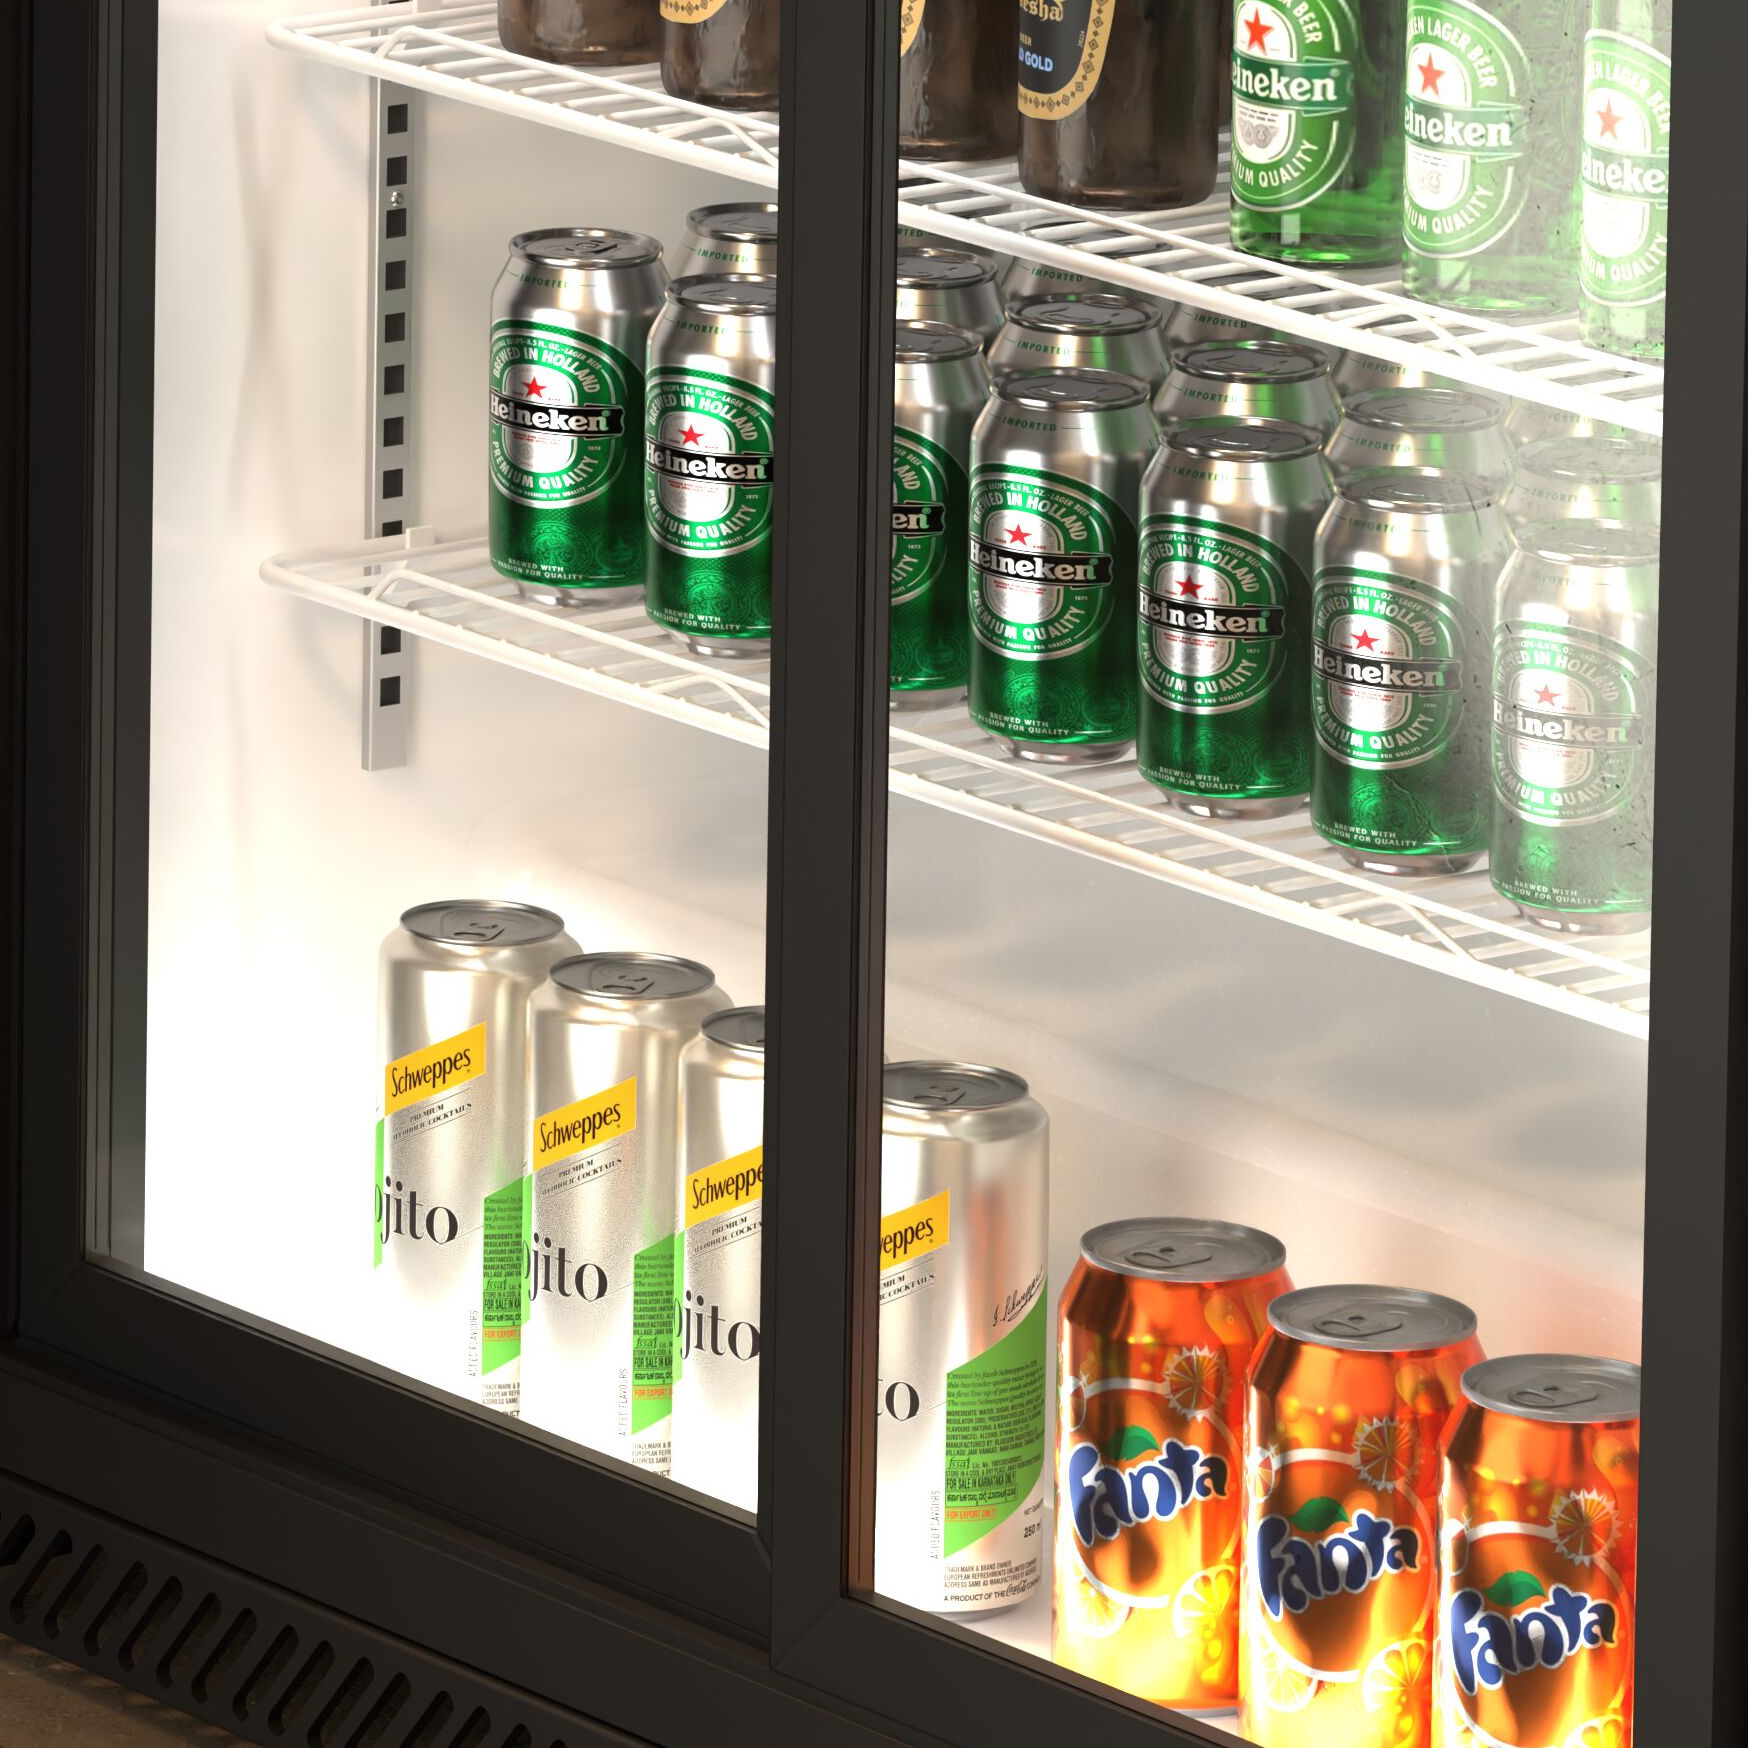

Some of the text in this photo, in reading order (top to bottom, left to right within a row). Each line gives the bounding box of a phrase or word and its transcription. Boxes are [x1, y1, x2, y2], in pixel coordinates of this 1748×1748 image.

[1293, 1, 1322, 46] BEER
[1024, 51, 1054, 73] GOLD
[1428, 17, 1497, 89] LAGER BEER
[1606, 62, 1650, 96] LAGER
[1259, 139, 1319, 188] QUALITY
[1582, 148, 1668, 195] eineke
[1431, 184, 1494, 235] QUALITY
[1031, 267, 1084, 282] IMPORTED
[1611, 231, 1667, 282] QUALITY
[1194, 313, 1248, 329] IMPORTED
[493, 346, 600, 393] BREWED IN HOLLAND
[490, 393, 609, 432] Heineken
[648, 393, 758, 441] BREWED IN HOLLAND
[1002, 417, 1057, 431] IMPORTED
[492, 441, 599, 490] PREMIUM QUALITY
[646, 446, 768, 480] Heineken
[648, 489, 756, 539] PREMIUM QUALITY
[973, 492, 1088, 541] BREWED IN HOLLAND
[525, 568, 584, 581] FOR QUALITY
[540, 564, 564, 572] WITH
[969, 539, 1097, 582] Heineken
[1142, 542, 1260, 593] BREWED IN HOLLAND
[682, 617, 741, 631] FOR QUALITY
[697, 614, 721, 623] WITH
[972, 589, 1086, 641] PREMIUM QUALITY
[1139, 591, 1269, 633] Heineken
[1318, 595, 1437, 646] BREWED IN HOLLAND
[1142, 642, 1258, 695] PREMIUM QUALITY
[1314, 644, 1445, 687] Heineken
[1533, 651, 1619, 701] IN HOLLAND
[1008, 723, 1070, 736] FOR QUALITY
[1024, 719, 1049, 727] WITH
[1316, 696, 1435, 749] PREMIUM QUALITY
[1178, 775, 1241, 791] FOR QUALITY
[1195, 773, 1220, 782] WITH
[1550, 770, 1617, 806] QUALITY
[1354, 832, 1417, 847] FOR QUALITY
[1370, 829, 1396, 838] WITH
[391, 1049, 471, 1098] Schweppes
[540, 1103, 621, 1153] Schweppes
[558, 1159, 594, 1178] PREMIUM
[692, 1164, 763, 1210] Schweppe
[711, 1216, 747, 1236] PREMIUM
[946, 1478, 956, 1489] FOR
[958, 1478, 970, 1489] SALE
[1068, 1438, 1230, 1548] Fanta
[1023, 1525, 1036, 1538] 250
[1256, 1511, 1421, 1621] Fanta
[950, 1589, 1007, 1602] PRODUCT OF THE
[1450, 1583, 1617, 1696] Fanta
